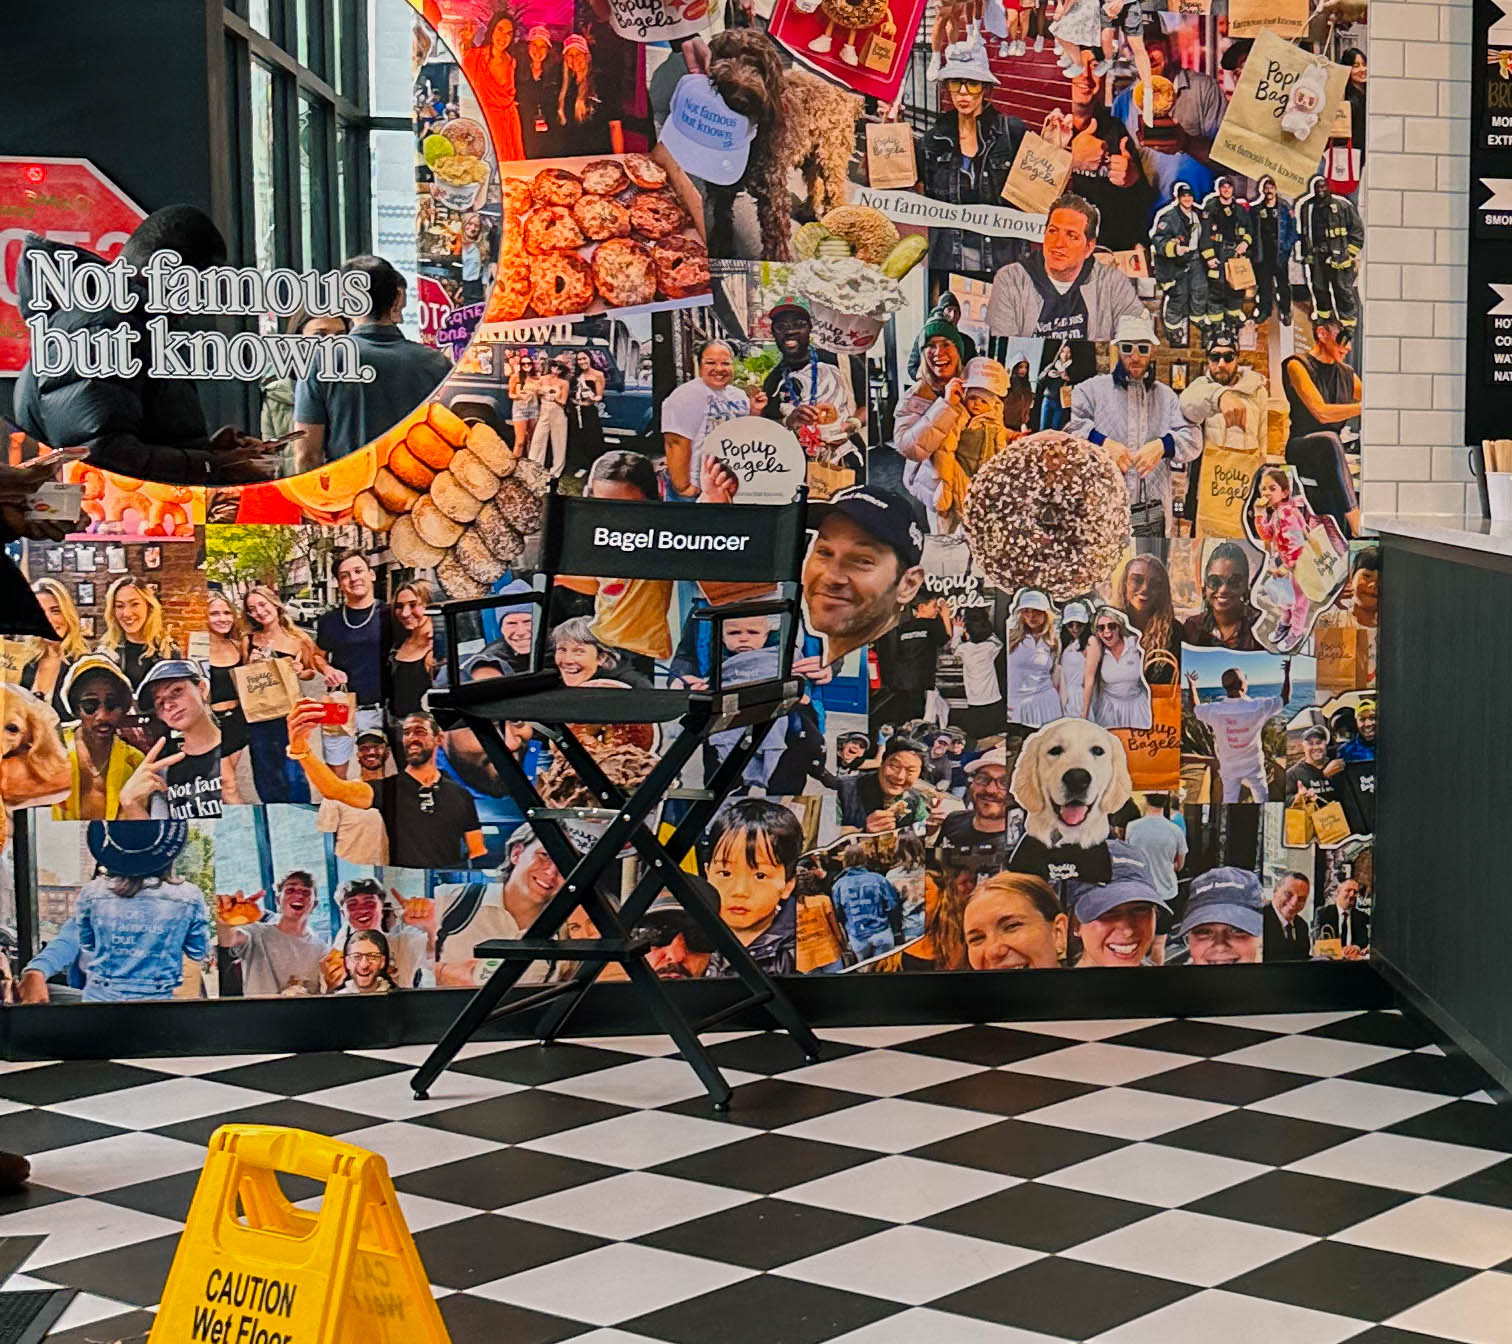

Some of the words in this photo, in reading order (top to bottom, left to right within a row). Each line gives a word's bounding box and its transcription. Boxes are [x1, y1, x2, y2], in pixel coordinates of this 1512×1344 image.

[616, 11, 682, 37] Bagels
[1266, 59, 1300, 91] Pop
[1255, 80, 1290, 118] Bag
[860, 192, 889, 211] Not
[894, 197, 957, 222] famous
[961, 208, 989, 227] but
[26, 249, 140, 312] Not
[142, 249, 373, 317] famous
[26, 312, 142, 378] but
[147, 315, 376, 384] known.
[1211, 481, 1251, 507] Bagel
[593, 527, 654, 552] Bagel
[658, 531, 750, 551] Bouncer
[937, 593, 995, 618] agels
[168, 783, 192, 800] Not
[195, 776, 222, 794] fam
[170, 803, 194, 820] but
[206, 1268, 297, 1318] CAUTION
